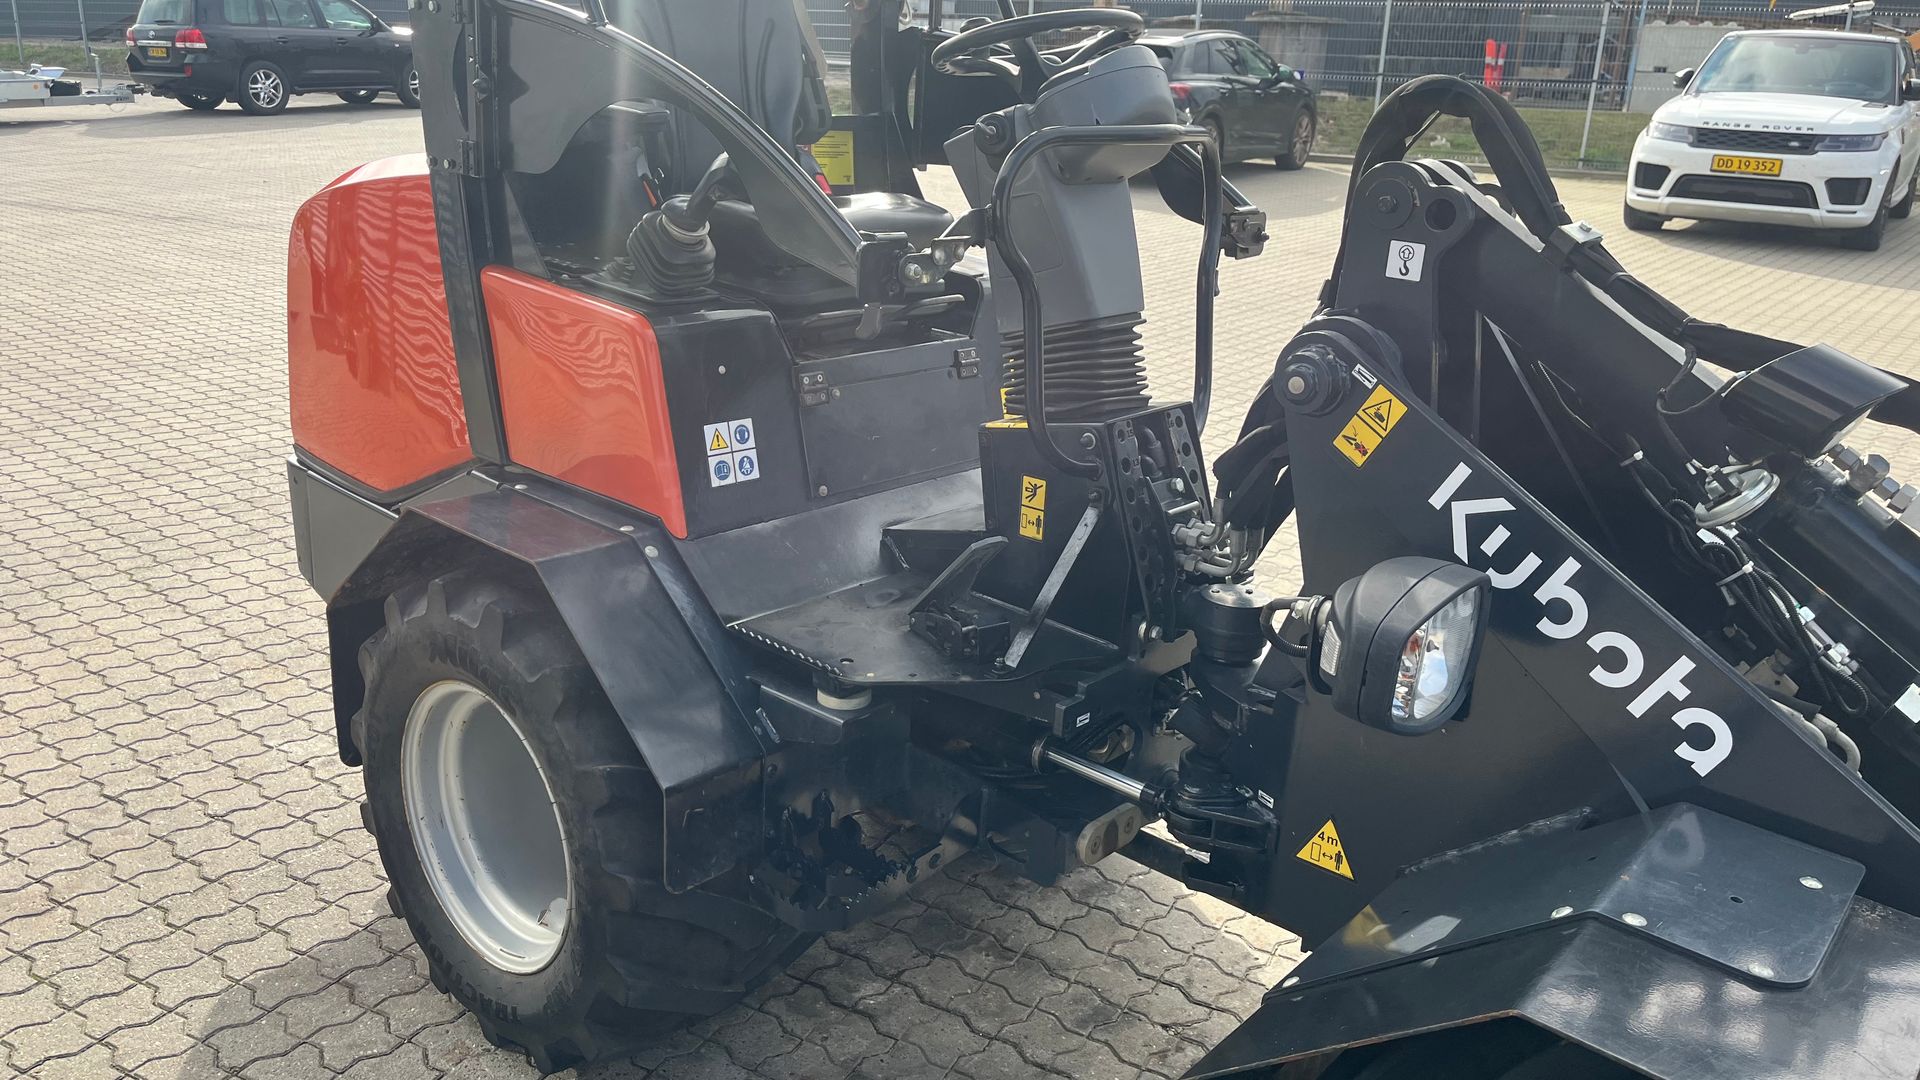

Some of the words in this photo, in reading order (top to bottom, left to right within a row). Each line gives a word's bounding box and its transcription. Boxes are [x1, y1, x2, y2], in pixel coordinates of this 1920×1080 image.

[1762, 124, 1814, 132] ROVER
[1717, 158, 1734, 169] DD
[1736, 159, 1751, 170] 19
[1753, 160, 1776, 172] 352
[1428, 461, 1733, 777] Kubota
[1318, 831, 1325, 842] 4
[1327, 835, 1338, 847] m
